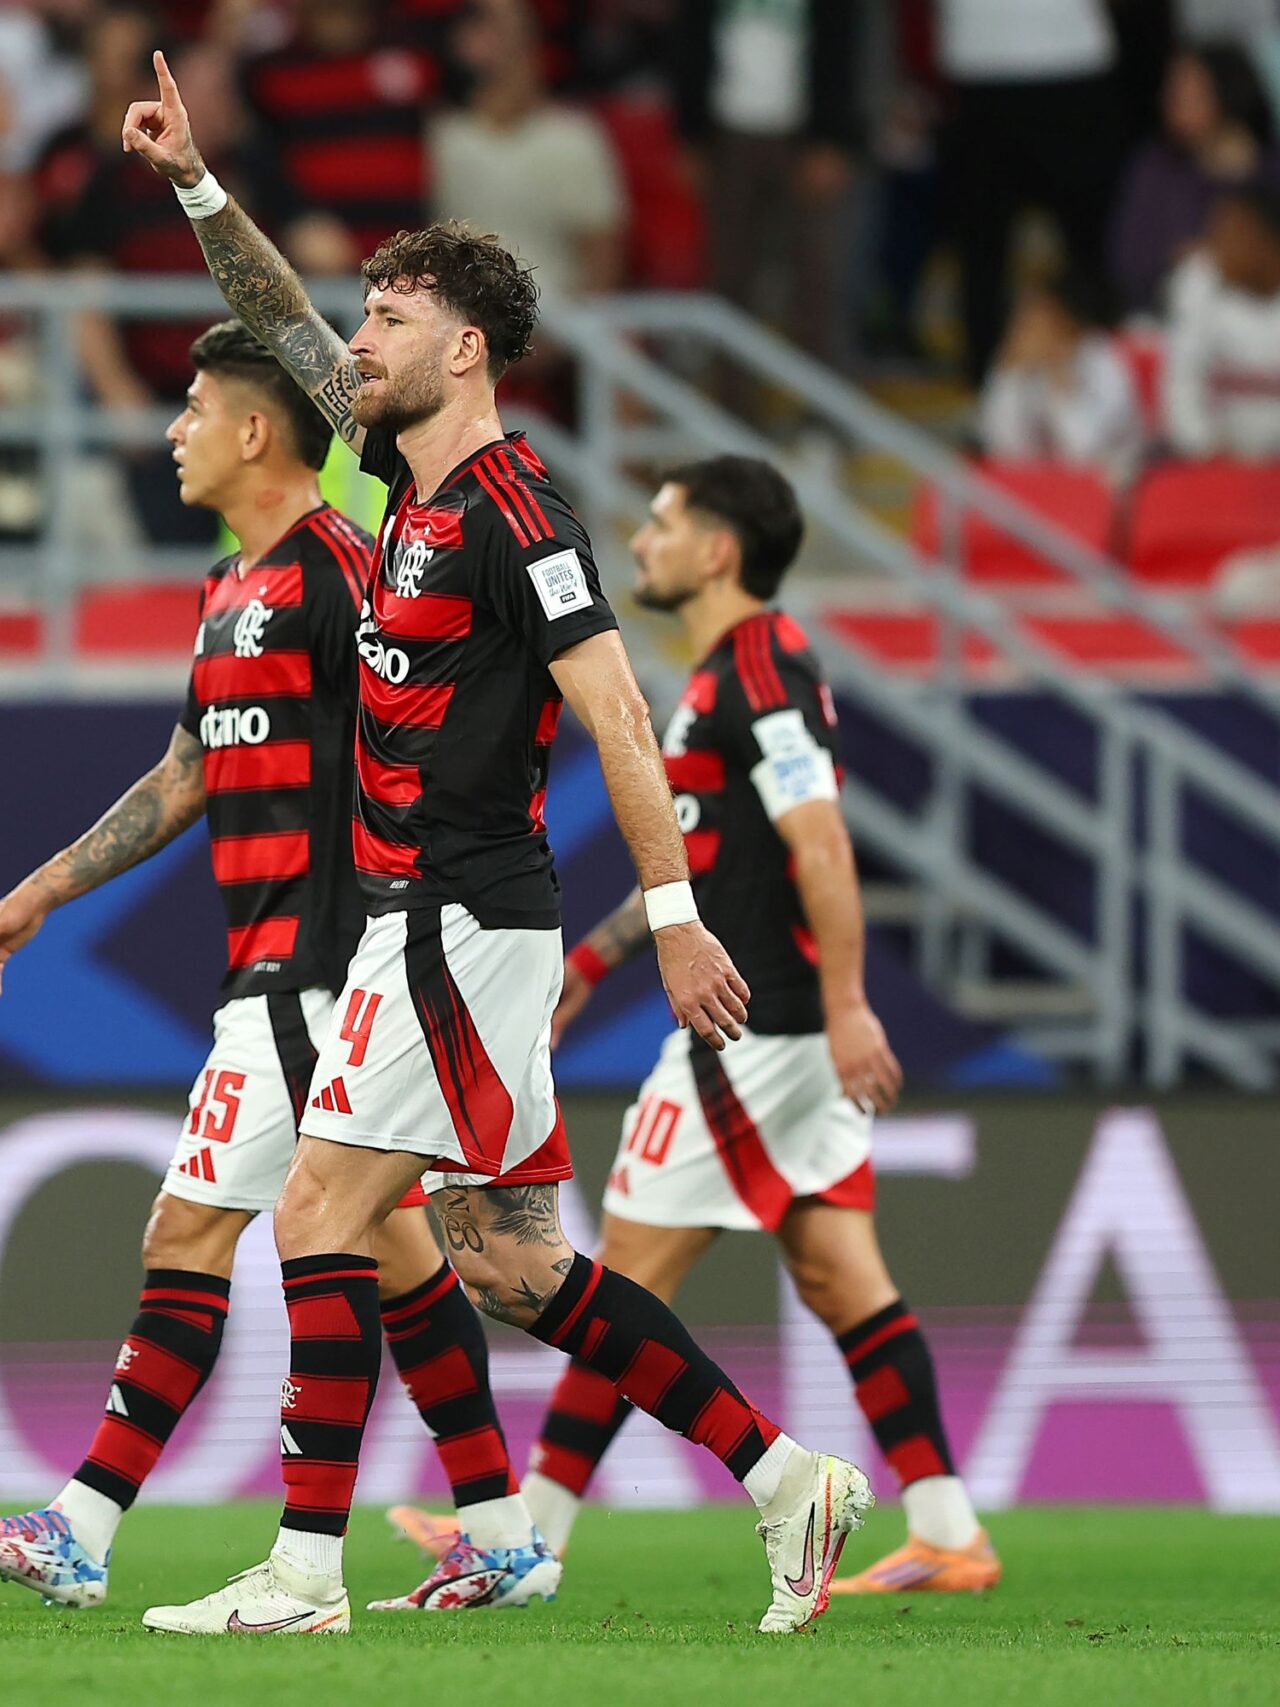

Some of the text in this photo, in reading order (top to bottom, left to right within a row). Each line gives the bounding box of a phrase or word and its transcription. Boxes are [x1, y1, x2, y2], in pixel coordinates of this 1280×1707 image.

[545, 569, 574, 587] UNITES
[339, 988, 384, 1067] 4
[189, 1069, 247, 1143] 15
[627, 1093, 682, 1165] 10
